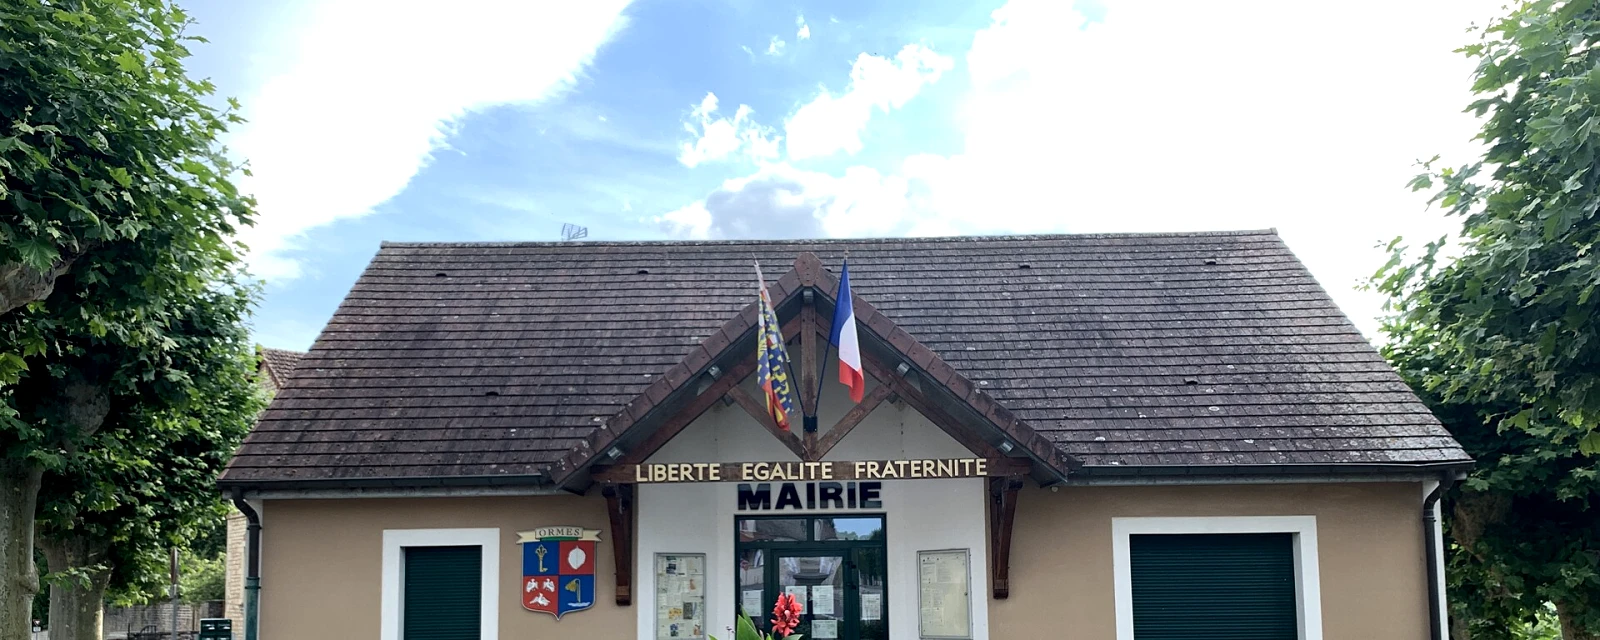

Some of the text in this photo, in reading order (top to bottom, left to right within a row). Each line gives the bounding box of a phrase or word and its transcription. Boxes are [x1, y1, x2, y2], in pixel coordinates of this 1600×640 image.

[635, 458, 988, 482] LIBERTE EGALITE FRATERNITE
[737, 482, 882, 510] MAIRIE
[538, 527, 581, 537] ORMES
